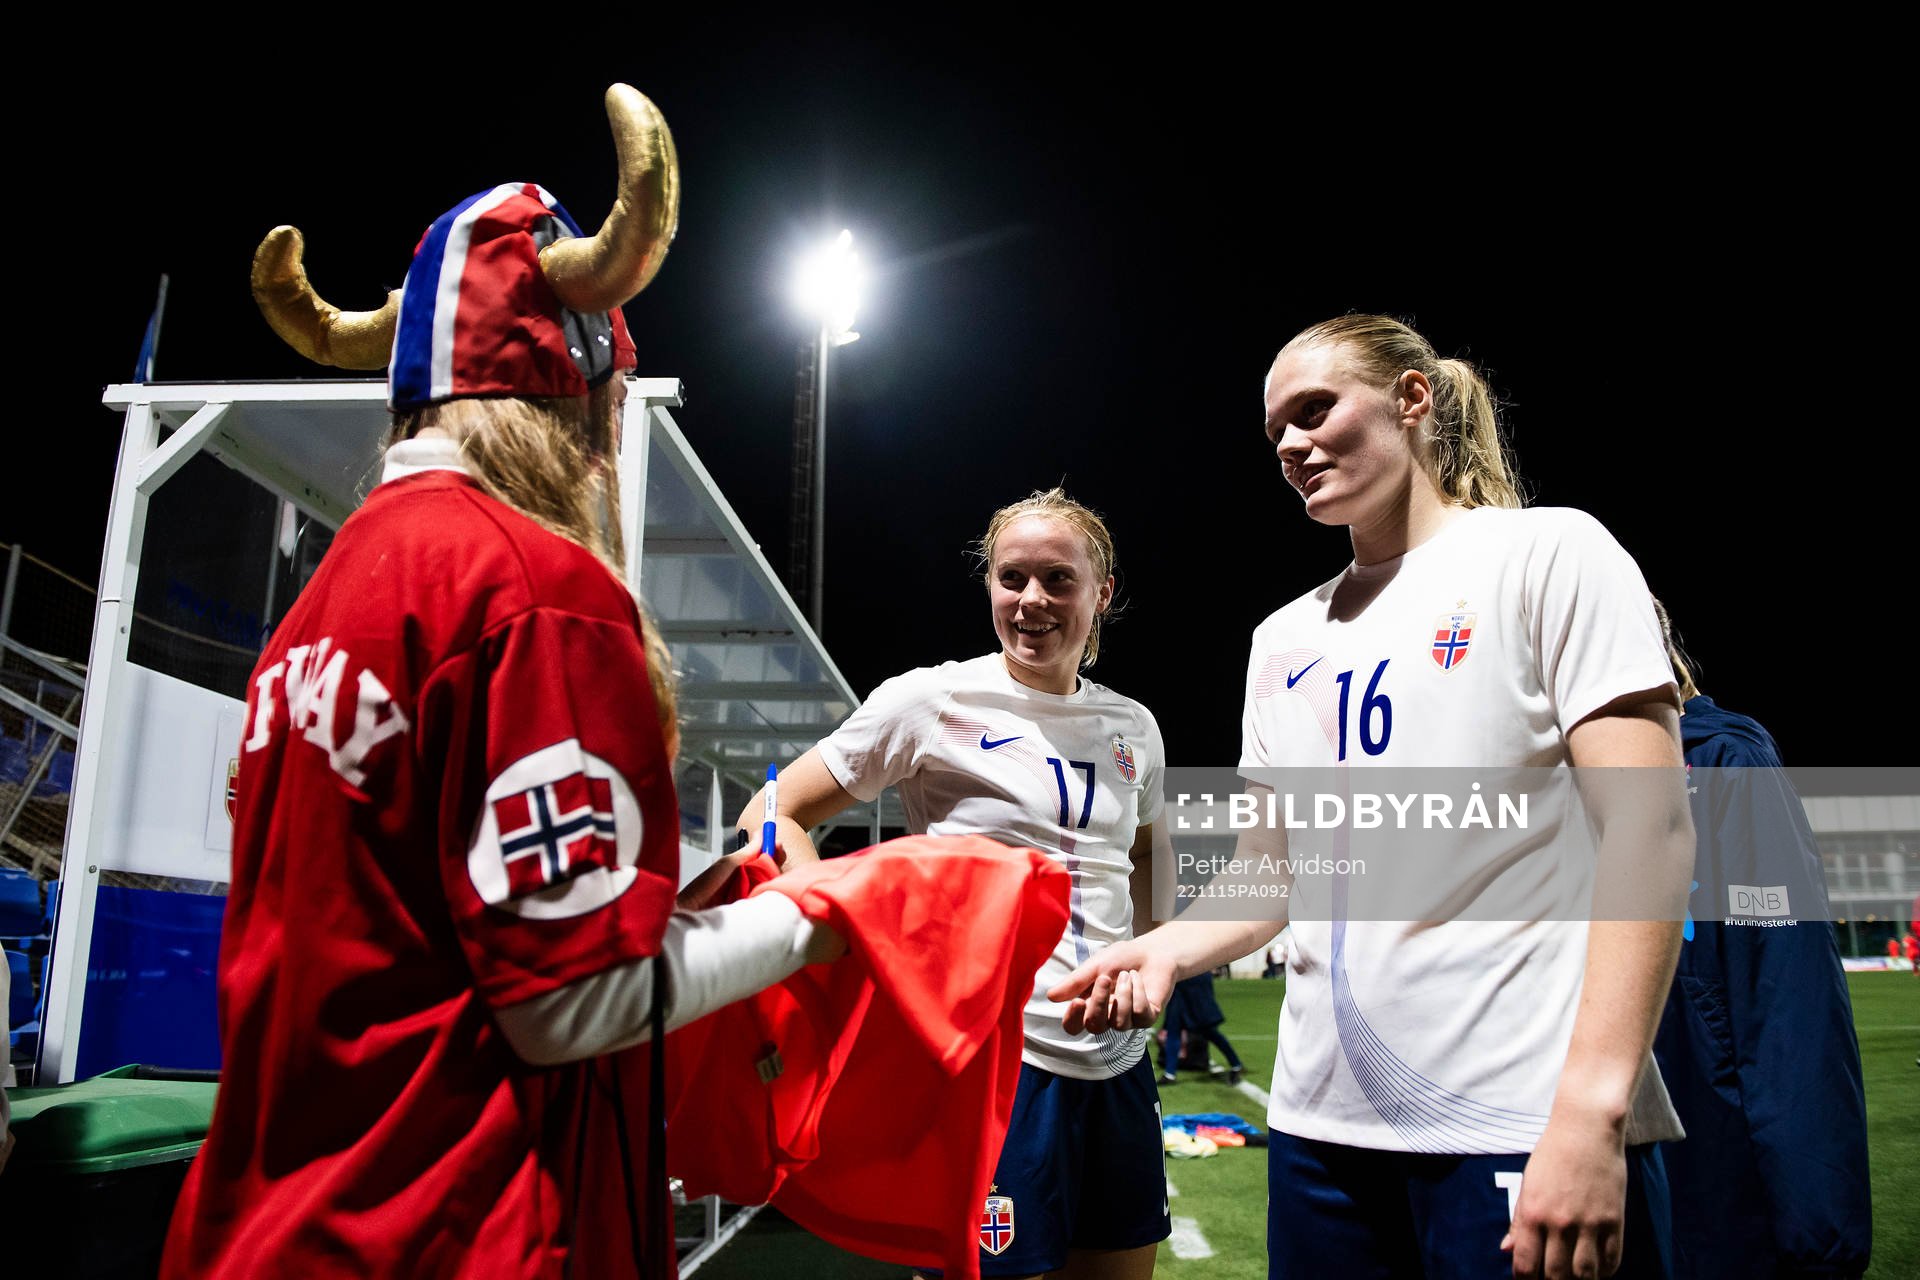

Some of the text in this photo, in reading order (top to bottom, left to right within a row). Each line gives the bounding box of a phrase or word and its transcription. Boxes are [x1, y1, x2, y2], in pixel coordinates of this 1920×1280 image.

[1336, 659, 1392, 762] 16
[1046, 757, 1095, 828] 17
[1725, 917, 1799, 928] #huninvesterer
[1737, 888, 1781, 916] DNB
